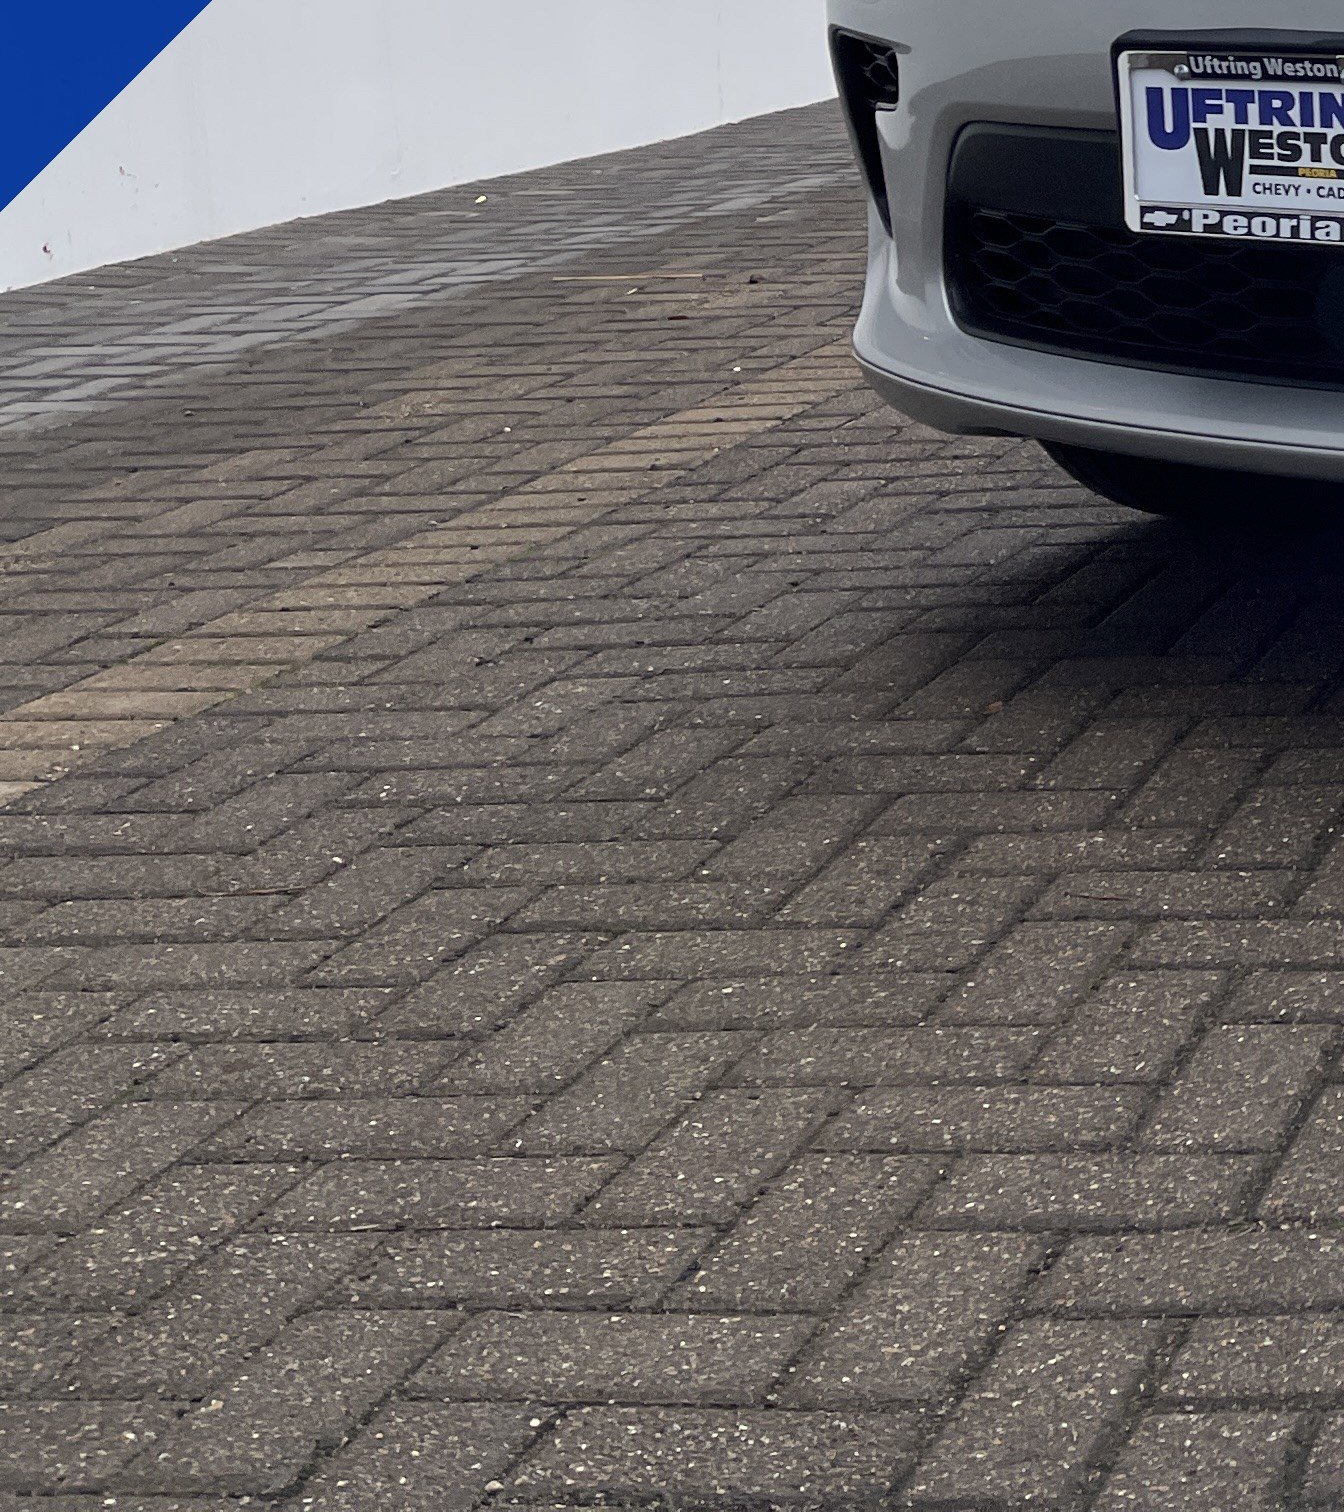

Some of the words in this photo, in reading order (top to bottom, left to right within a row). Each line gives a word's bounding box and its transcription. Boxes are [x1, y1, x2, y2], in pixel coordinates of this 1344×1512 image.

[1189, 55, 1263, 79] Uftring
[1263, 58, 1339, 78] Weston
[1298, 167, 1338, 179] PEORIA
[1252, 182, 1301, 197] CHEVY
